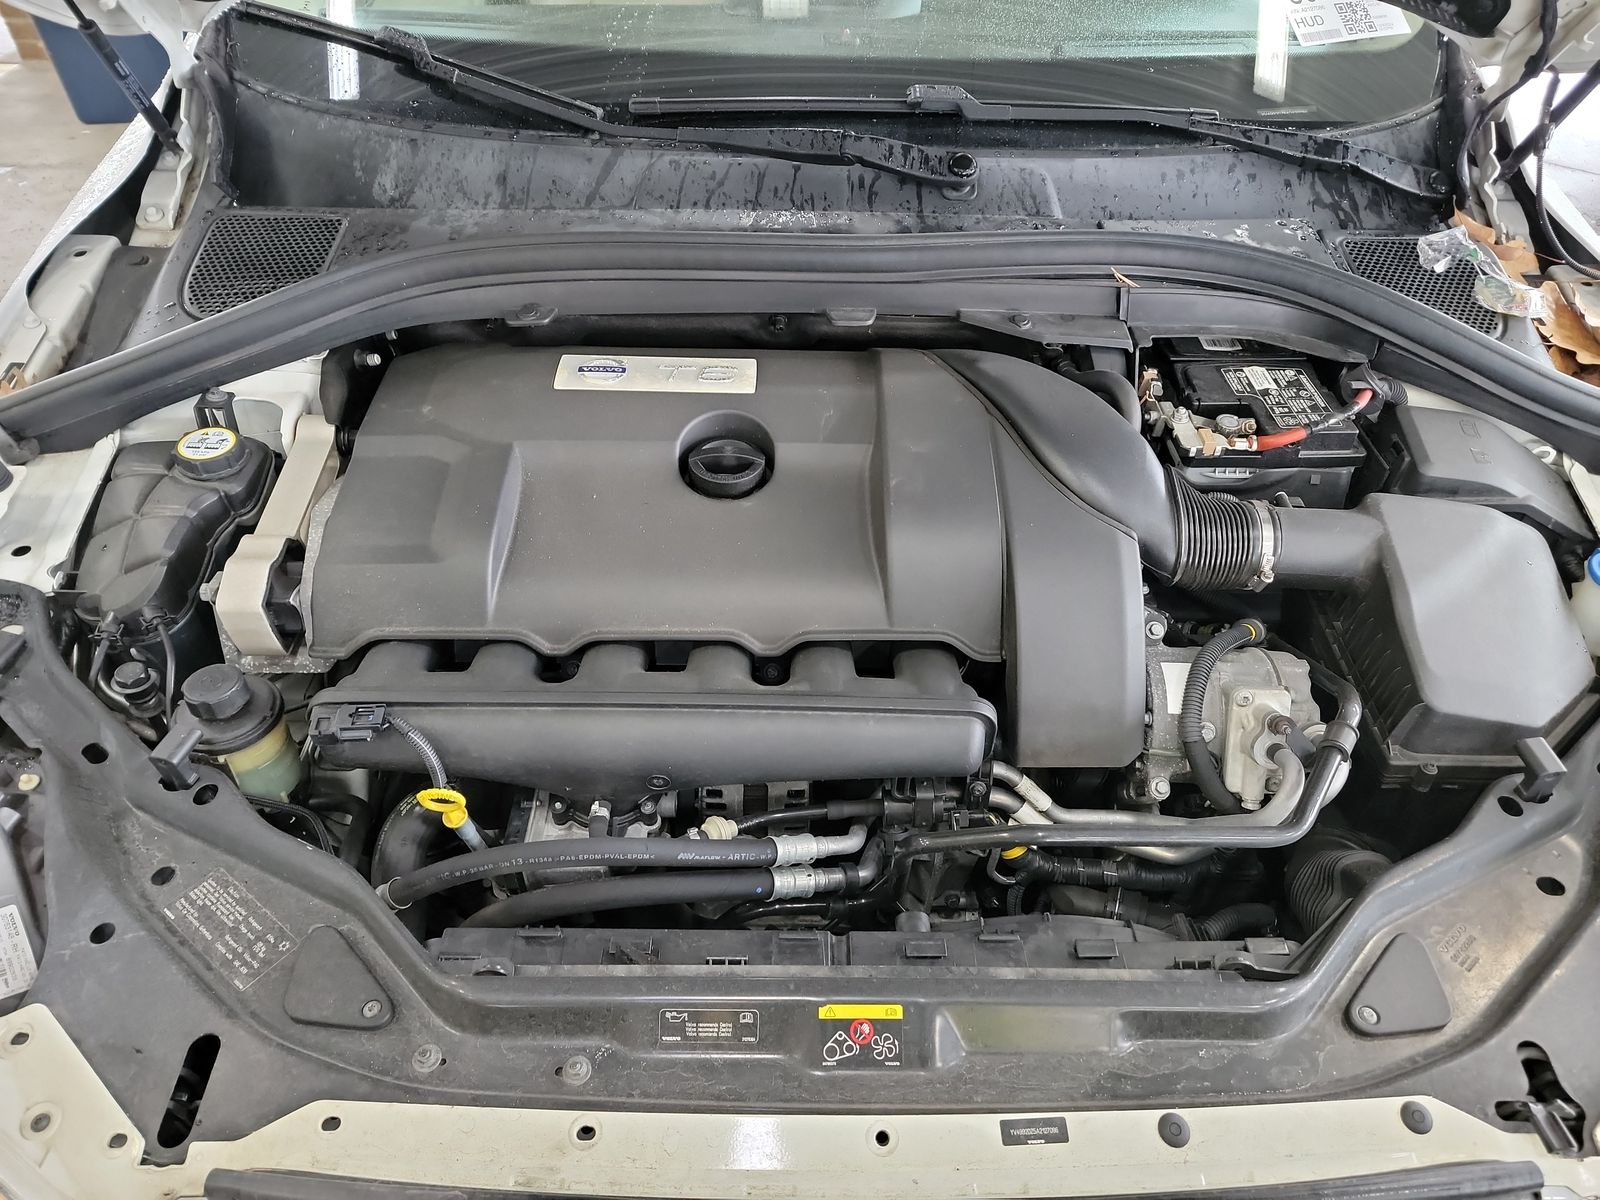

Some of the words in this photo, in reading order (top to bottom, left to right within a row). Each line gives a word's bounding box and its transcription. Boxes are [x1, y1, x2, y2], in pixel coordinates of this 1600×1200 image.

[1295, 14, 1325, 29] HUD
[657, 364, 738, 383] T6
[727, 853, 756, 861] ARTIC
[8, 912, 20, 936] VOLVO
